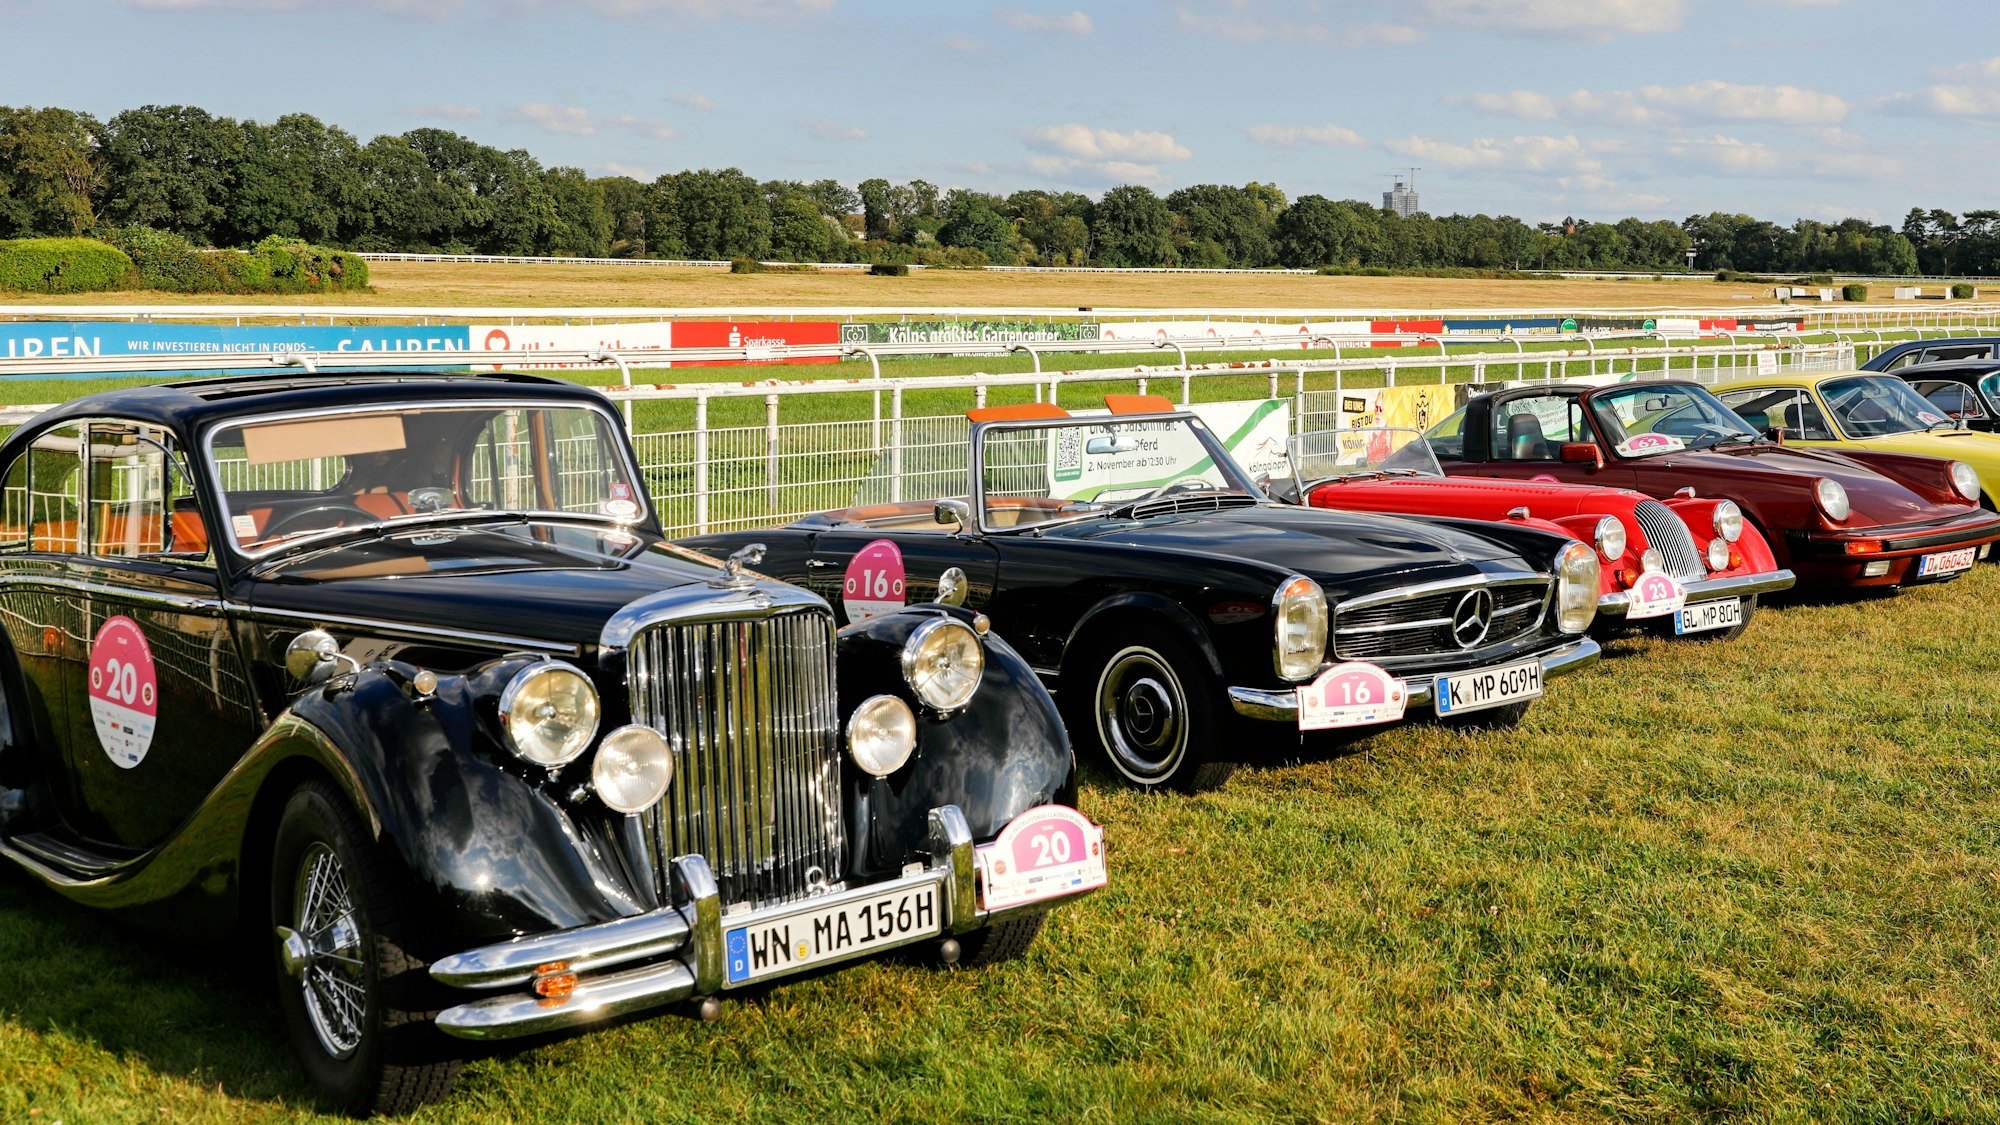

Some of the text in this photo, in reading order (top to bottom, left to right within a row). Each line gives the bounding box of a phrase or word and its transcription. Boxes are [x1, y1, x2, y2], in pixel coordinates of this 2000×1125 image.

[744, 335, 786, 347] Sparkasse
[889, 326, 1060, 343] Kölns größtes Gartencenter
[127, 340, 149, 351] WIR
[152, 341, 219, 352] INVESTIEREN
[223, 343, 255, 352] NICHT
[259, 343, 270, 352] IN
[273, 342, 306, 352] FONDS
[1344, 400, 1364, 411] BEI UNS
[1365, 414, 1373, 425] DU
[1638, 438, 1659, 448] 62
[1088, 461, 1095, 472] 2.
[1097, 458, 1134, 471] November
[1136, 458, 1147, 467] ab
[1165, 456, 1177, 465] Uhr
[1926, 557, 1935, 572] D
[1939, 551, 1973, 571] 060432
[863, 569, 888, 598] 16
[1649, 582, 1667, 600] 23
[1683, 610, 1697, 628] GL
[1702, 607, 1717, 626] MP
[1719, 603, 1741, 623] 80H
[106, 658, 137, 705] 20
[1450, 680, 1462, 705] K
[1473, 675, 1495, 701] MP
[1500, 666, 1539, 695] 609H
[1342, 681, 1370, 704] 16
[1031, 830, 1071, 867] 20
[735, 890, 933, 972] D WN MA 156H
